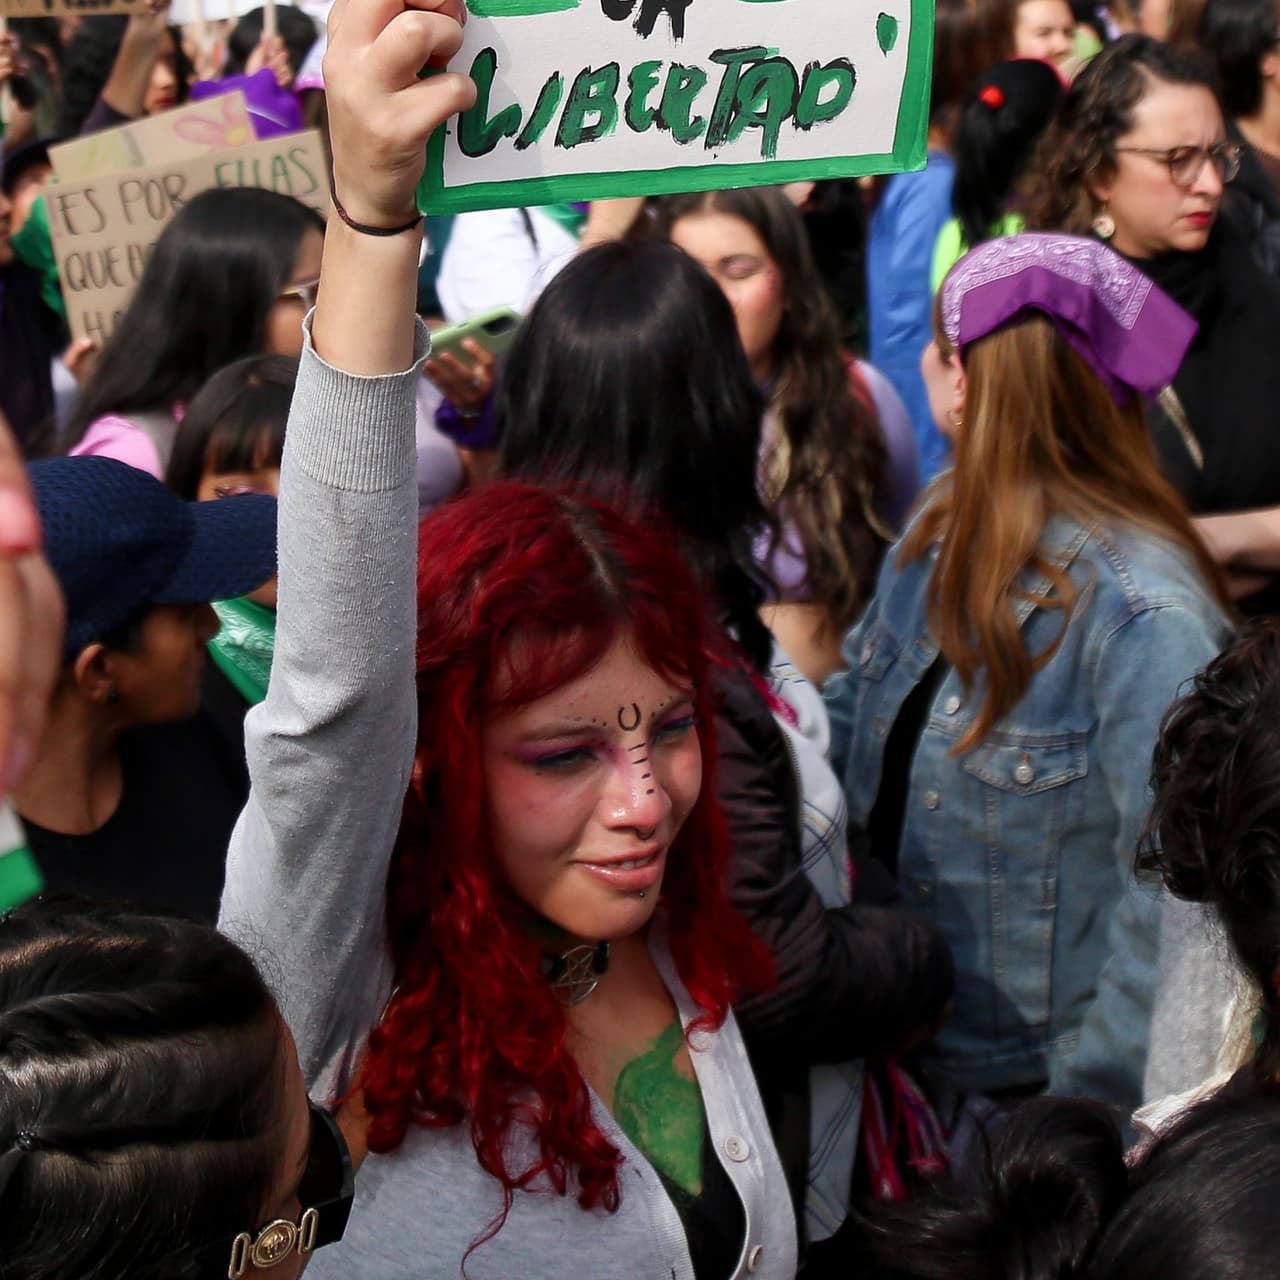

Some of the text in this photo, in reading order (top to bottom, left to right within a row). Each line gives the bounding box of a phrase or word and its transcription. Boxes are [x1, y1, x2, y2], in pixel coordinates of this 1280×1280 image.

[457, 46, 856, 159] LIBERTAD
[58, 187, 106, 235] ES
[119, 174, 188, 225] POR
